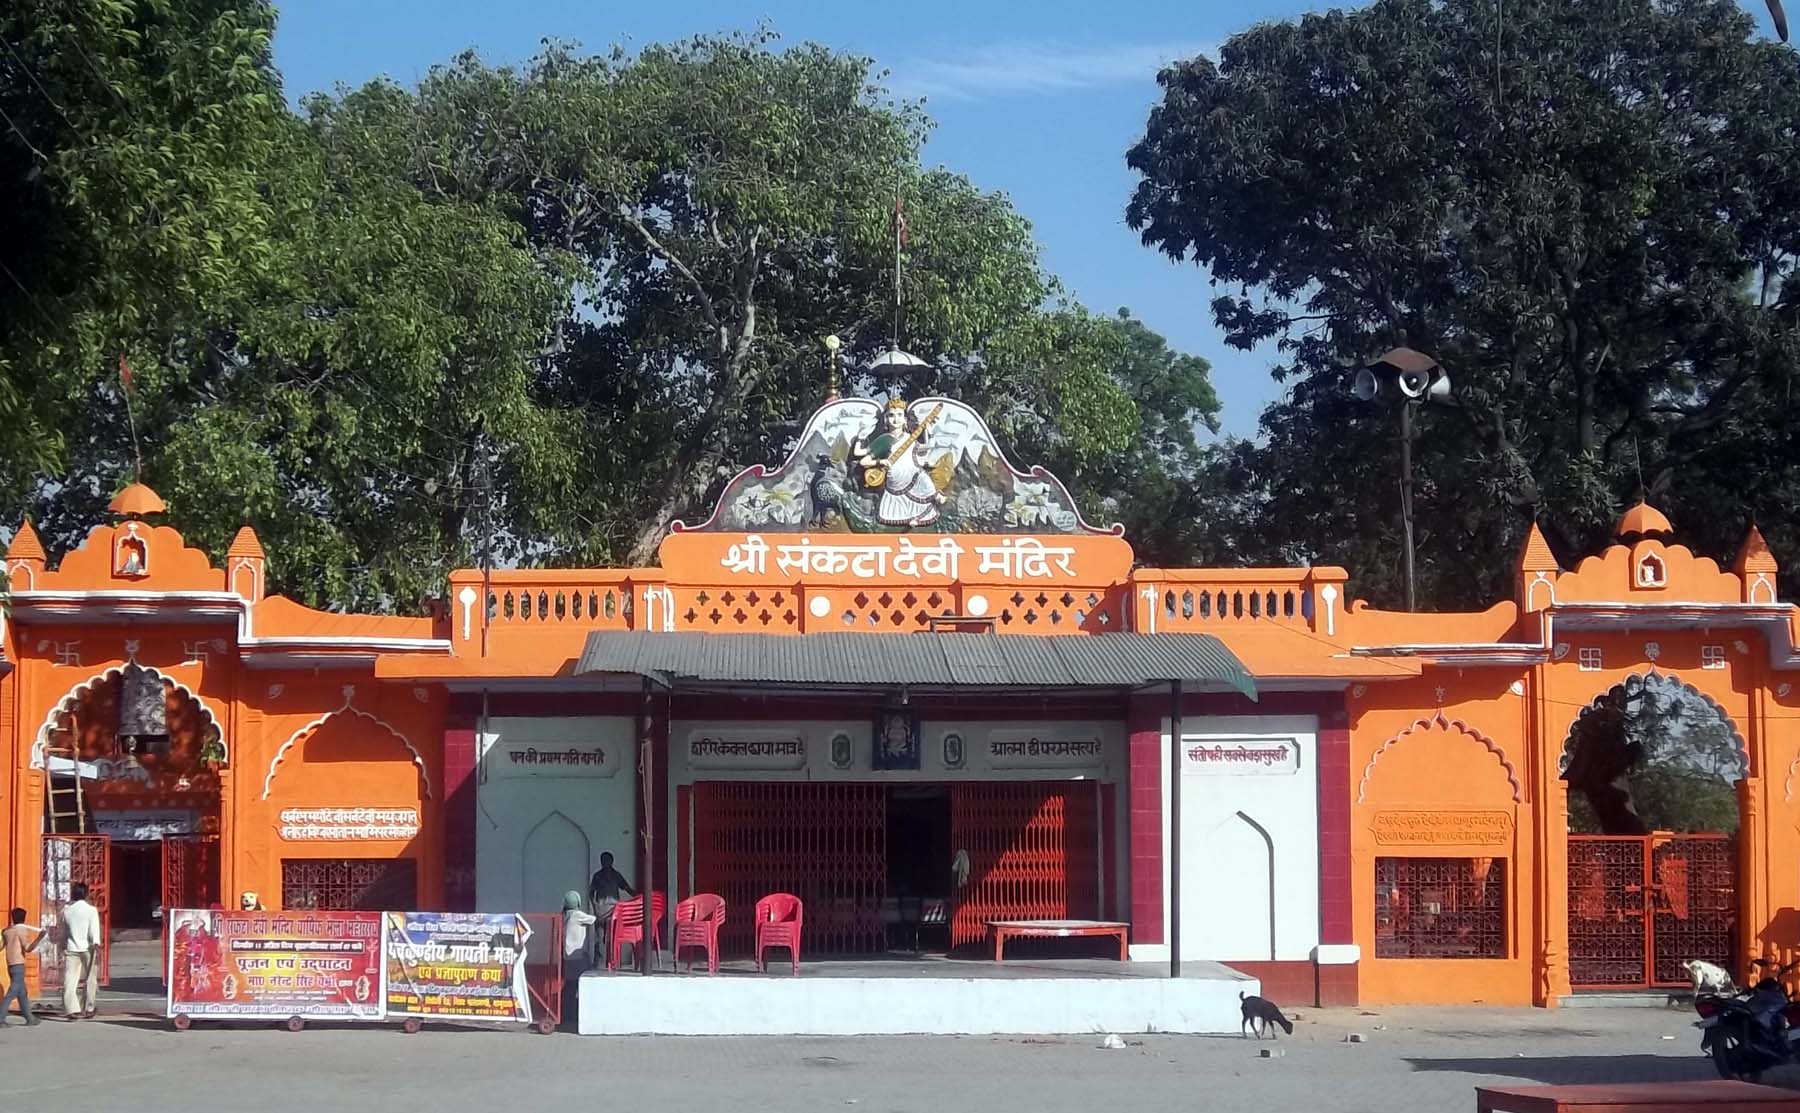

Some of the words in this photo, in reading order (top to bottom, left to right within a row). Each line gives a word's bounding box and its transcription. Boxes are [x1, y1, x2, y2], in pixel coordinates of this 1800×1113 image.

[720, 536, 770, 575] श्री
[776, 538, 892, 578] संकटा
[892, 537, 967, 579] देवी
[974, 537, 1076, 579] मंदिर
[1027, 738, 1040, 756] ही
[1040, 741, 1069, 756] परम
[1070, 741, 1095, 756] सत्य
[1214, 745, 1223, 761] ही
[237, 958, 269, 972] पूजन
[276, 954, 297, 969] एवं
